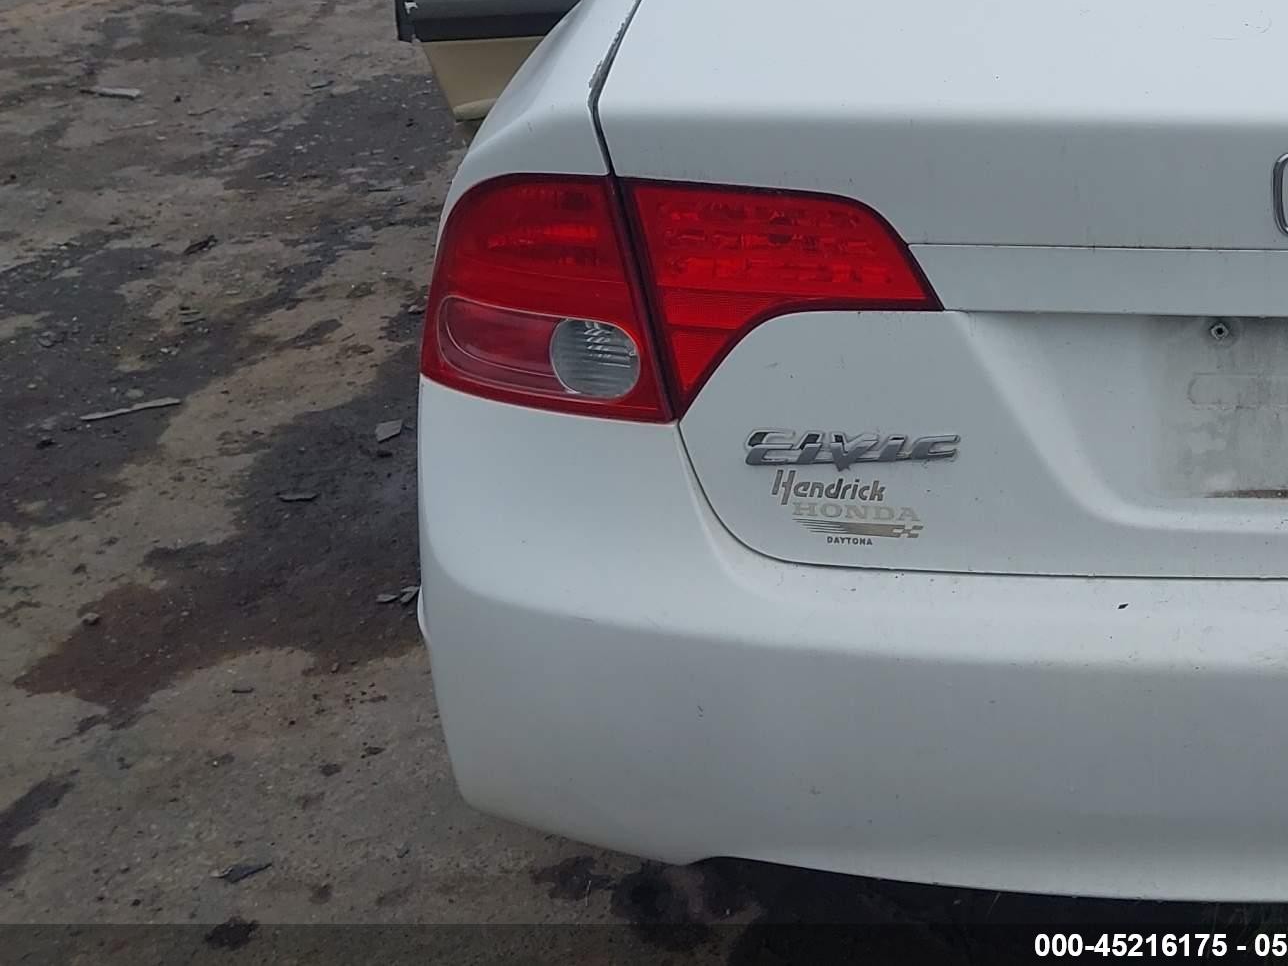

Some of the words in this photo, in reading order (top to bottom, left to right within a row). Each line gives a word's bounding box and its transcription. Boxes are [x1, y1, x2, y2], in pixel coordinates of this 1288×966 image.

[771, 469, 886, 505] Hendrick
[792, 501, 921, 522] HONDA
[826, 536, 873, 546] DAYTONA
